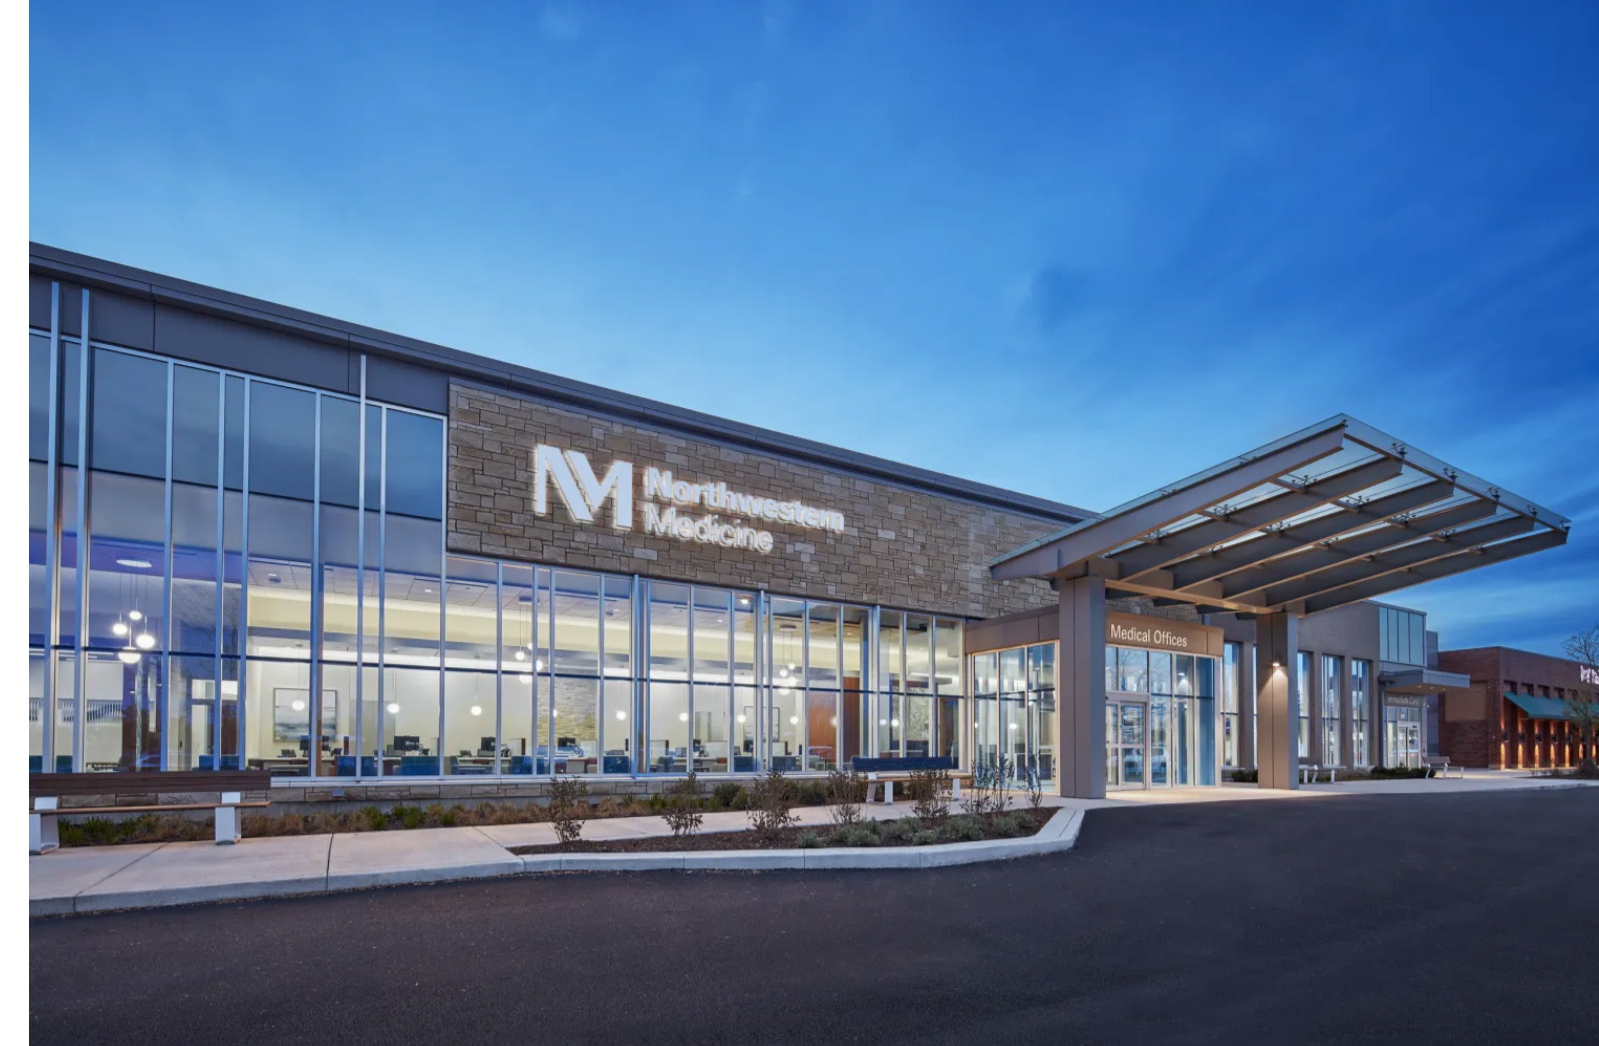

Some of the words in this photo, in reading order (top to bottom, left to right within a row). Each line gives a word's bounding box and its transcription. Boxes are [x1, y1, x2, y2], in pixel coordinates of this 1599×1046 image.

[646, 466, 846, 532] Northwestern
[646, 502, 775, 554] Medicine
[1110, 623, 1151, 642] Medical
[1153, 629, 1188, 647] Offices
